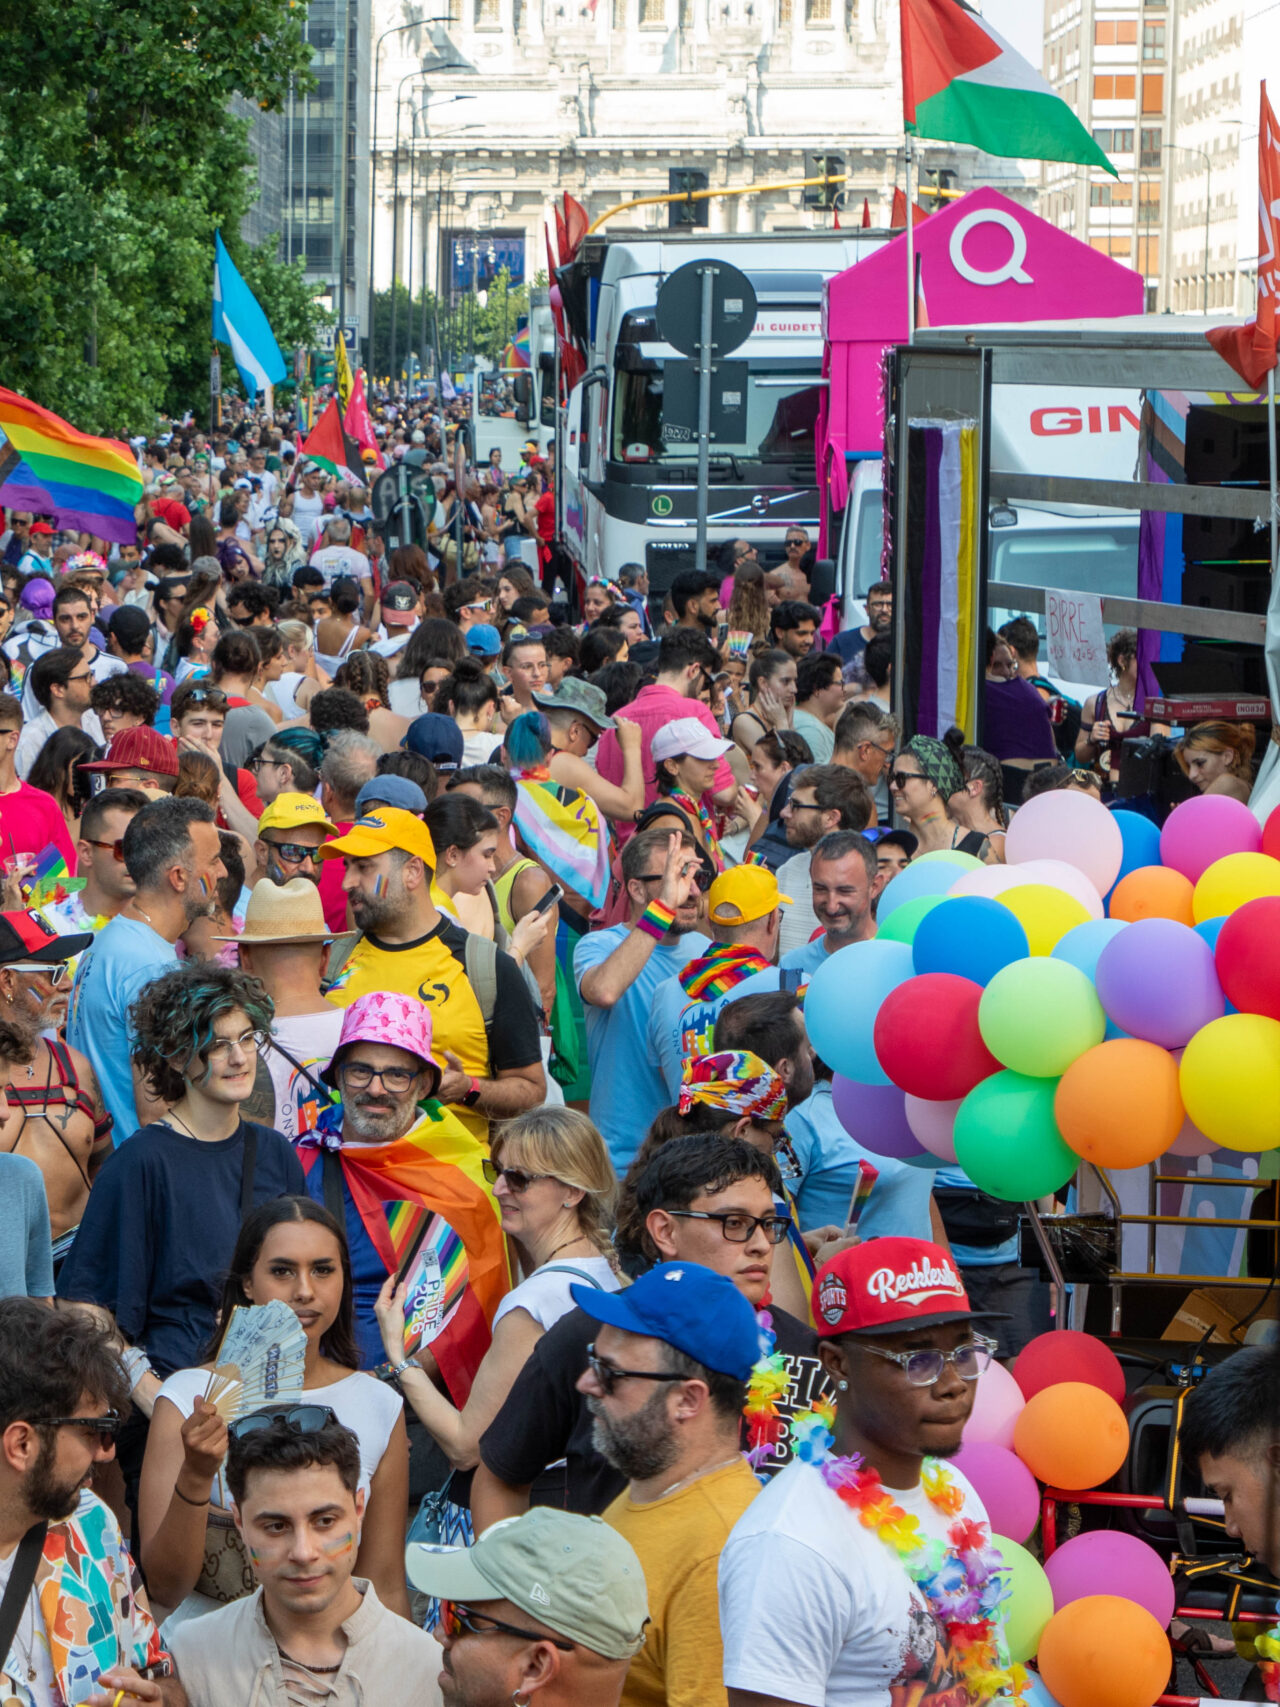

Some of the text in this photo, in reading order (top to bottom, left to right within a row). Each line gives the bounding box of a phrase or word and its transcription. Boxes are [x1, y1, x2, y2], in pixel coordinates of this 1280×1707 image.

[949, 208, 1034, 286] Q
[1049, 596, 1089, 643] BIRRE
[410, 1283, 428, 1335] 2026
[424, 1279, 441, 1332] PRIDE
